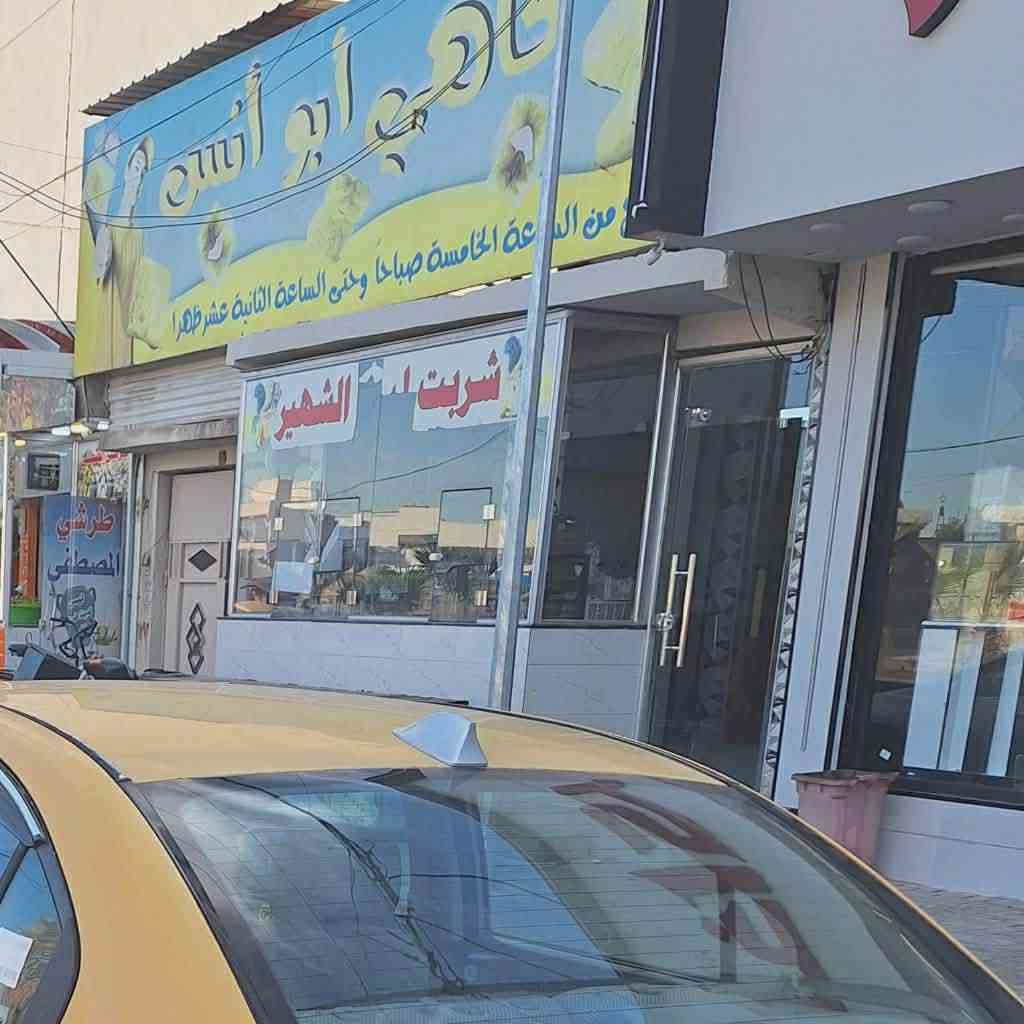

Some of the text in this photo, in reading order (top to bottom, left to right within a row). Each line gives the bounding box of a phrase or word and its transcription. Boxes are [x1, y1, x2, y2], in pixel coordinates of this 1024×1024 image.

[503, 202, 578, 254] السعة
[583, 206, 616, 240] من
[427, 224, 497, 272] الخامسة
[274, 270, 326, 309] الساعة
[202, 301, 228, 336] عشر
[417, 349, 502, 419] شربت
[274, 374, 352, 441] الشهير
[56, 503, 115, 542] طرشي
[48, 547, 120, 582] المصطفى
